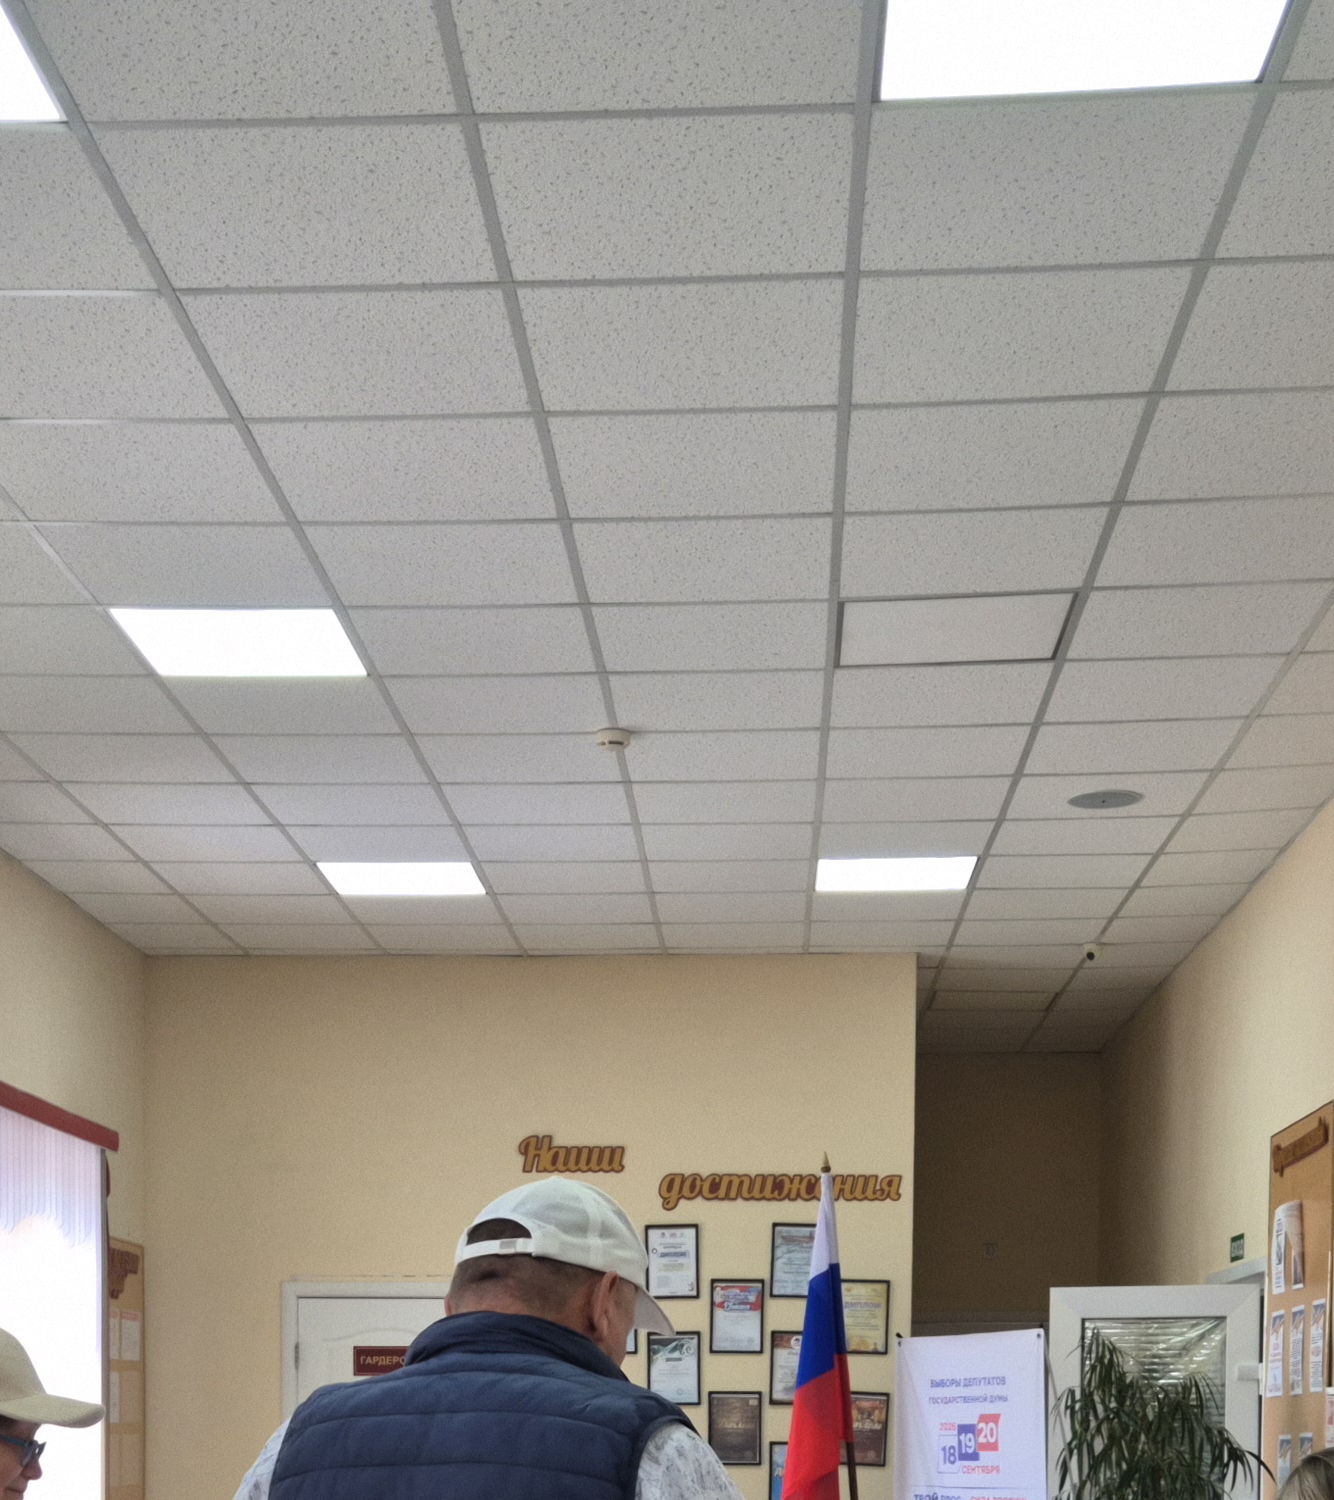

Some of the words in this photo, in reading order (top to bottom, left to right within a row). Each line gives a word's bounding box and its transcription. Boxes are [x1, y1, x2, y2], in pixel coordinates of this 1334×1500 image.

[519, 1135, 625, 1173] Наши
[360, 1356, 406, 1366] ГАРДЕРО
[962, 1376, 1006, 1387] ДЕПУТАТОВ
[978, 1422, 997, 1443] 20
[959, 1433, 975, 1453] 19
[941, 1445, 957, 1465] 18
